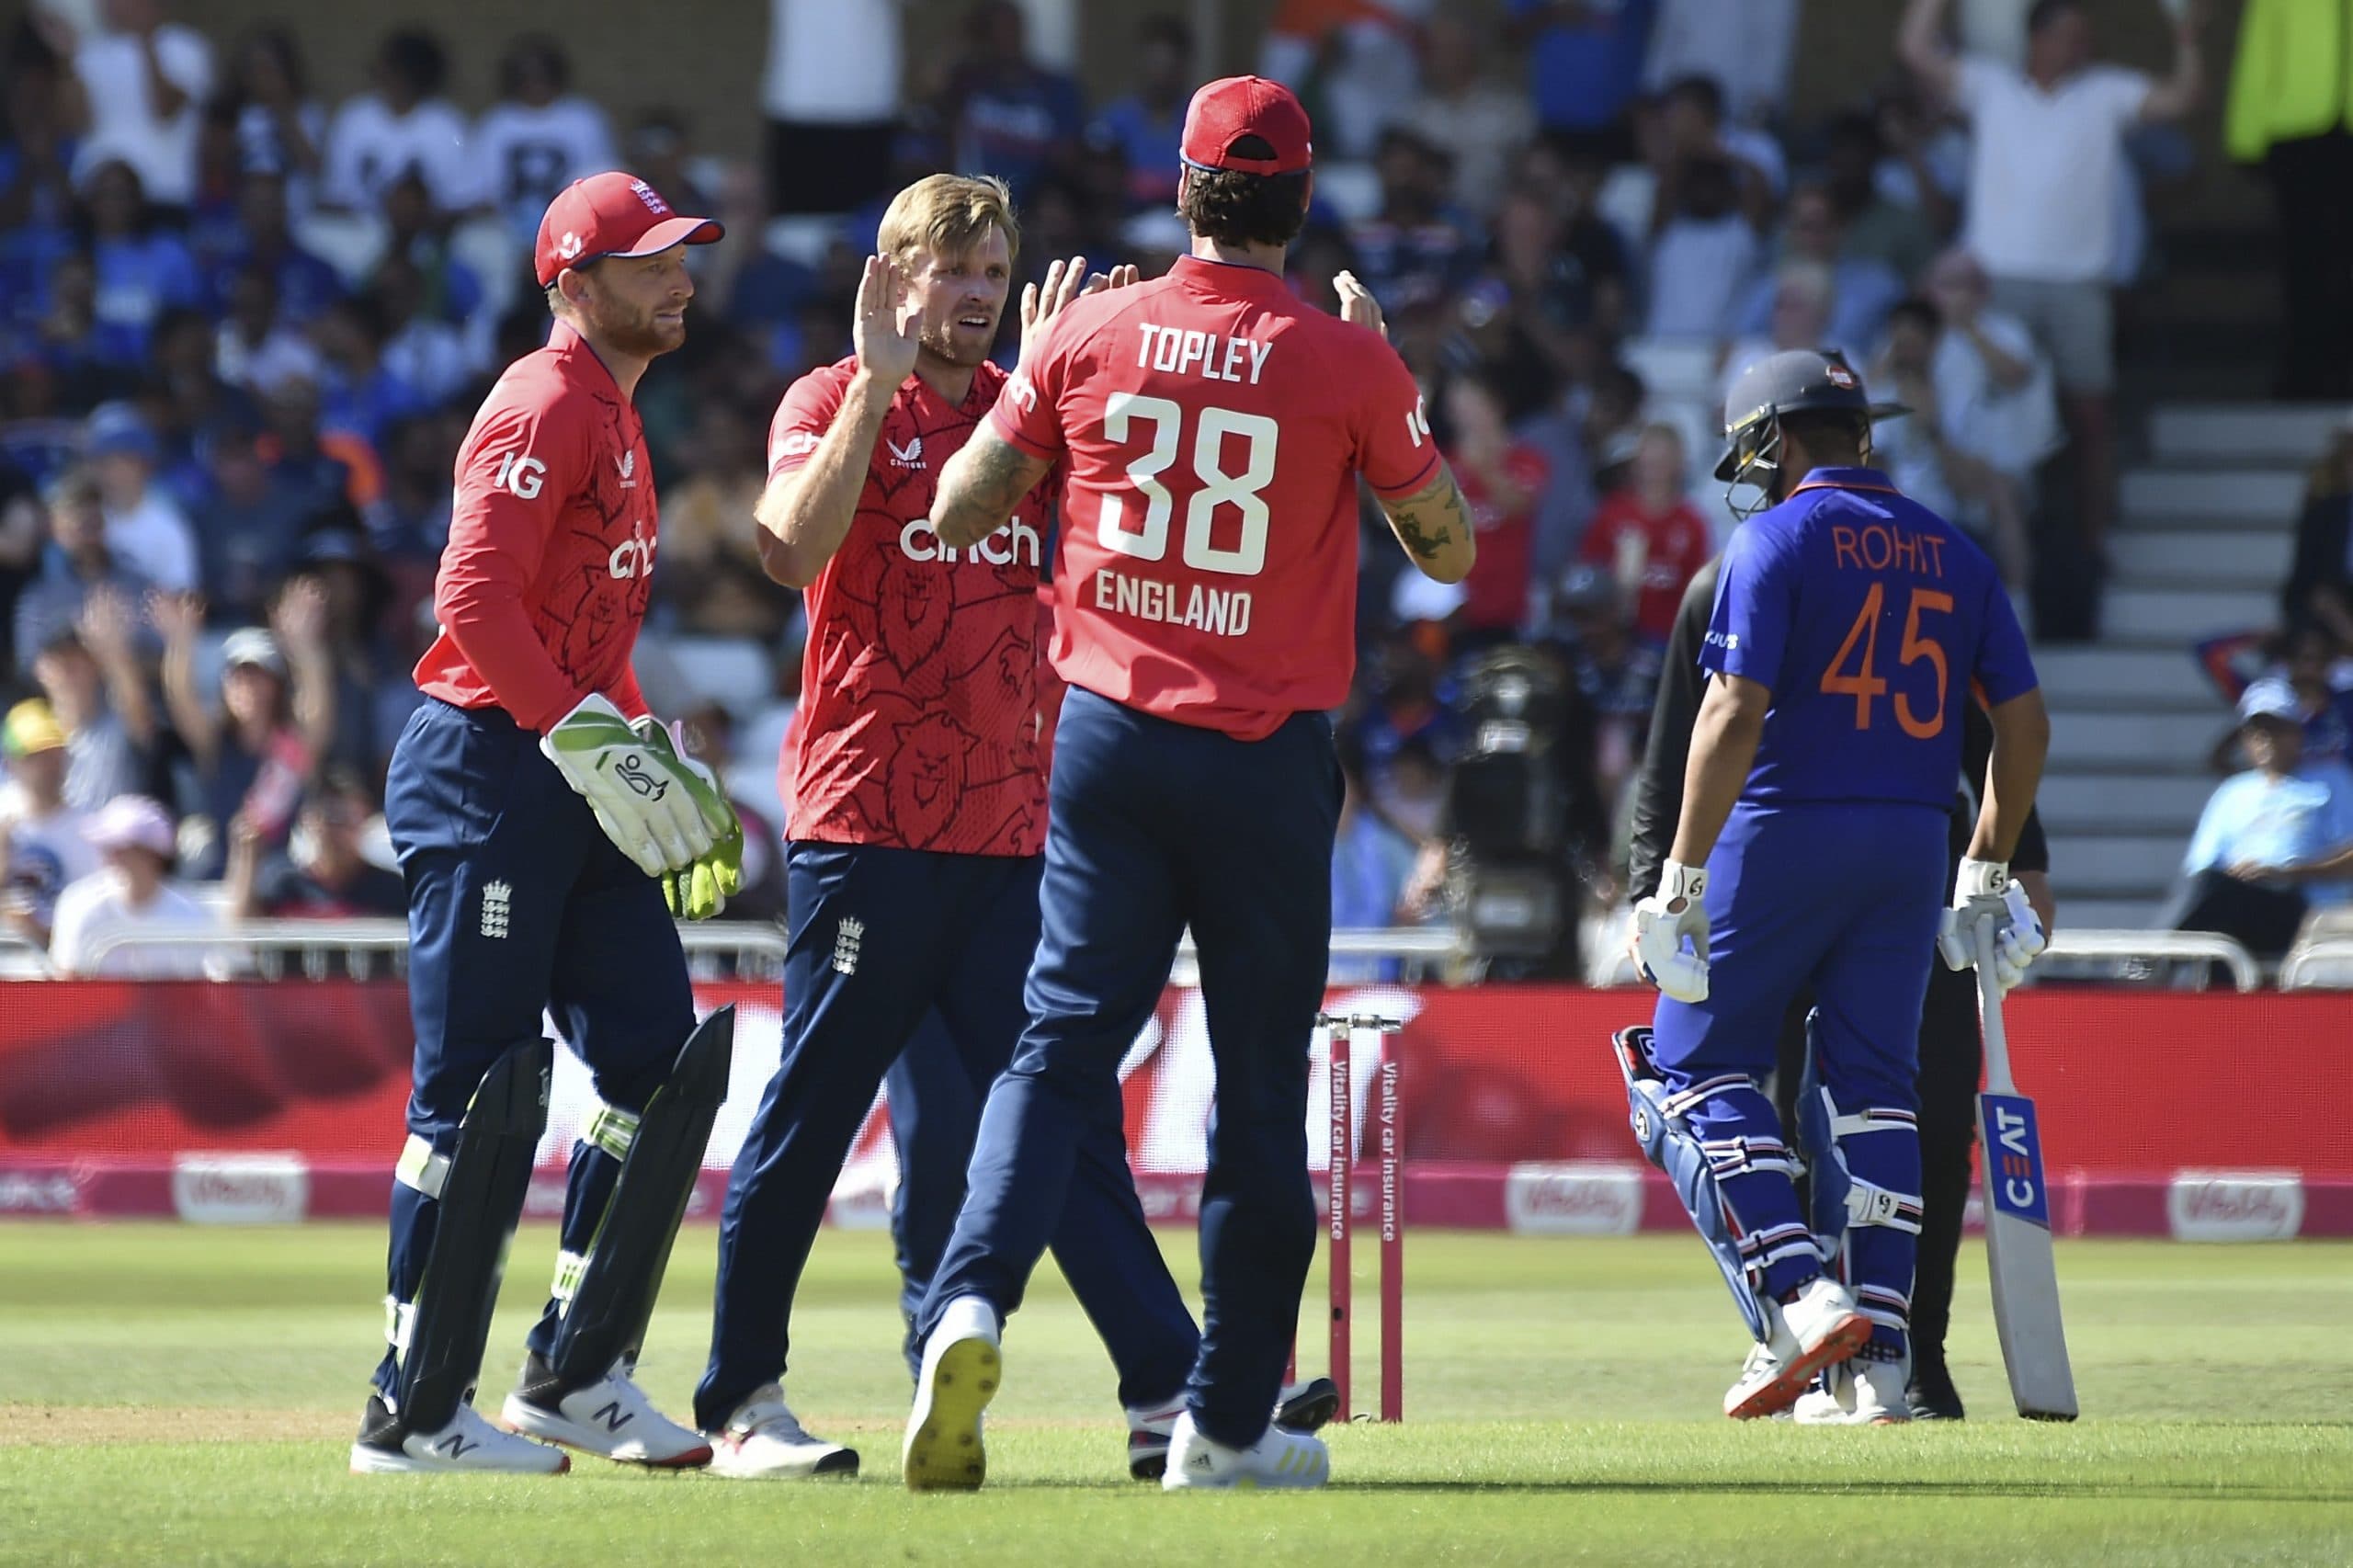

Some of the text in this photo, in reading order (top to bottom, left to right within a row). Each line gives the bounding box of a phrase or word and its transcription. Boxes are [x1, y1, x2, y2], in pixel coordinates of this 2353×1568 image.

[1138, 323, 1272, 385] TOPLEY
[494, 451, 546, 499] IG
[1097, 391, 1279, 576] 38
[1832, 525, 1947, 578] ROHIT
[1096, 569, 1252, 637] ENGLAND
[1820, 583, 1954, 739] 45
[1331, 1061, 1347, 1240] Vitality car insurance
[1381, 1062, 1398, 1242] Vitality car insurance
[1995, 1106, 2035, 1208] CEAT
